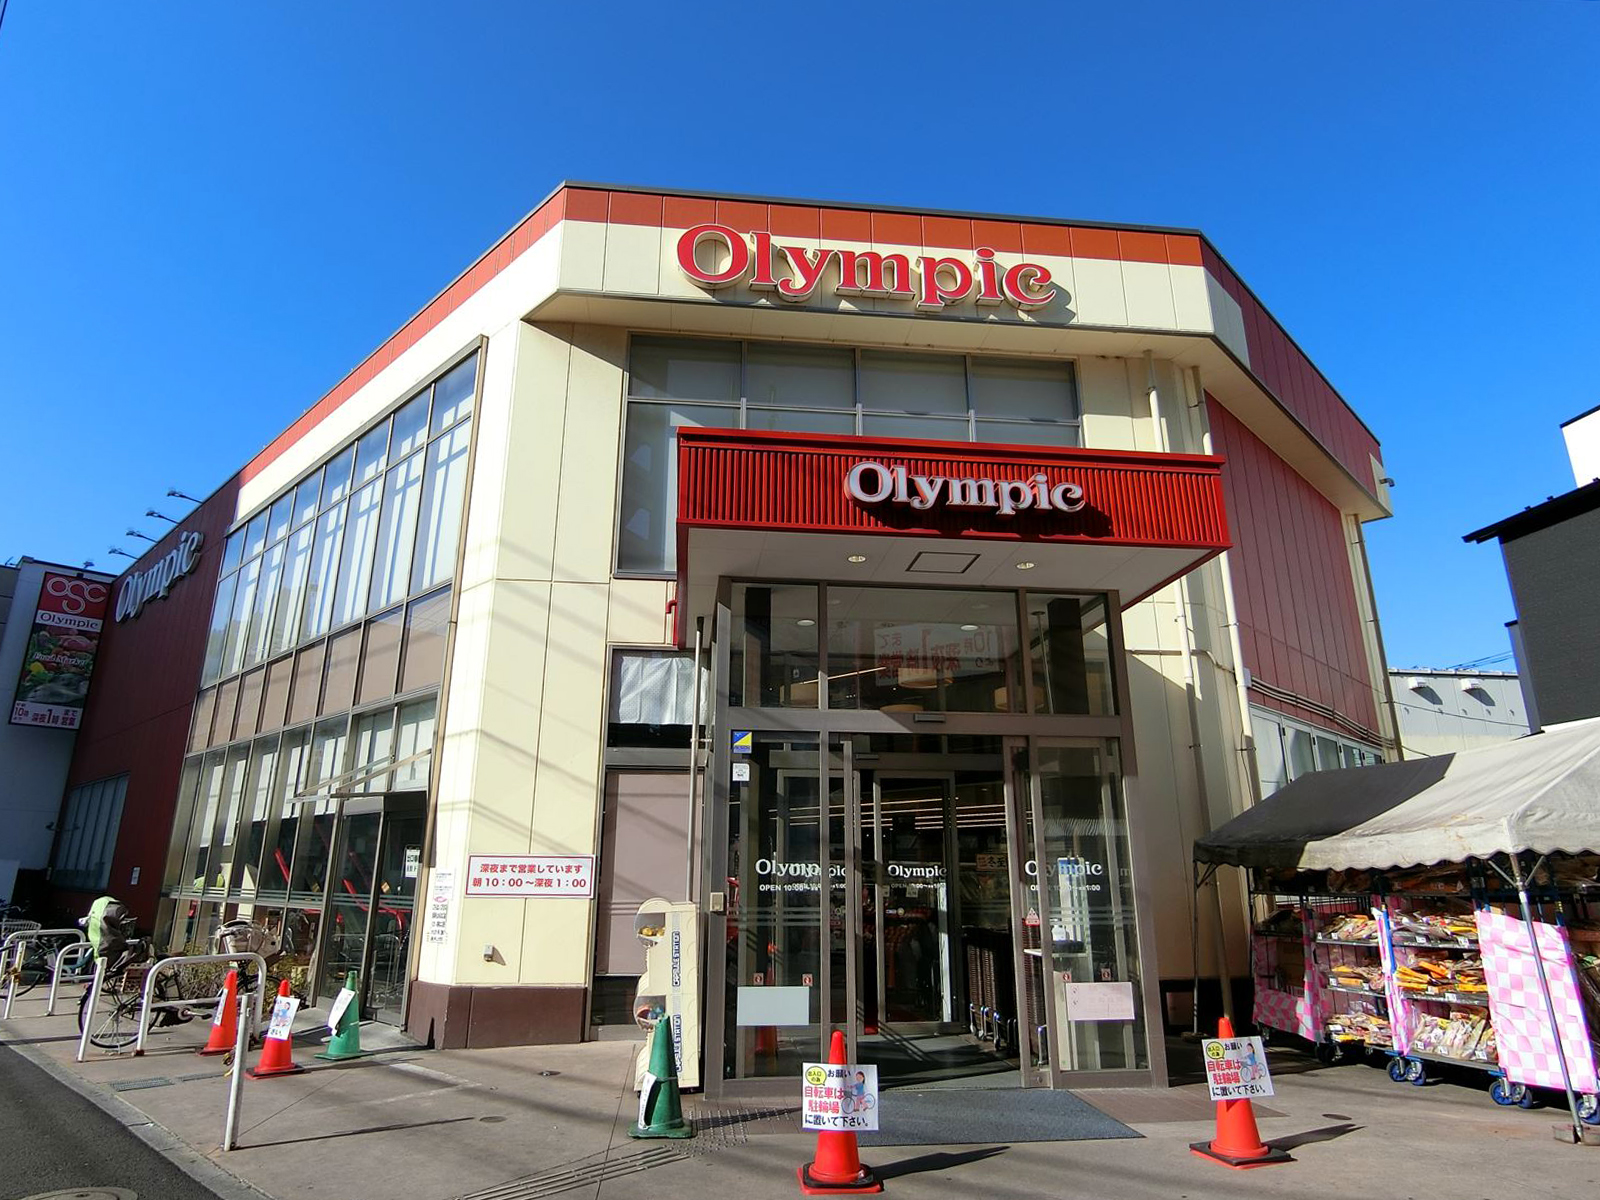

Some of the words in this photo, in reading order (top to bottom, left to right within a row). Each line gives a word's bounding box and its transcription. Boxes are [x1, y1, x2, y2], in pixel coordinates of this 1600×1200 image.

[676, 223, 1057, 311] Olympic
[844, 461, 1086, 515] Olympic
[115, 530, 203, 622] Olympic
[40, 612, 98, 630] Olympic
[480, 863, 583, 874] 深夜まで営業しています
[888, 864, 948, 878] Olympic
[1024, 860, 1103, 877] Oympic
[759, 884, 781, 892] OPEN
[1207, 1059, 1242, 1072] 自転車は
[827, 1069, 852, 1078] お願い
[804, 1086, 845, 1100] 自転車は
[808, 1100, 840, 1114] 駐輪場
